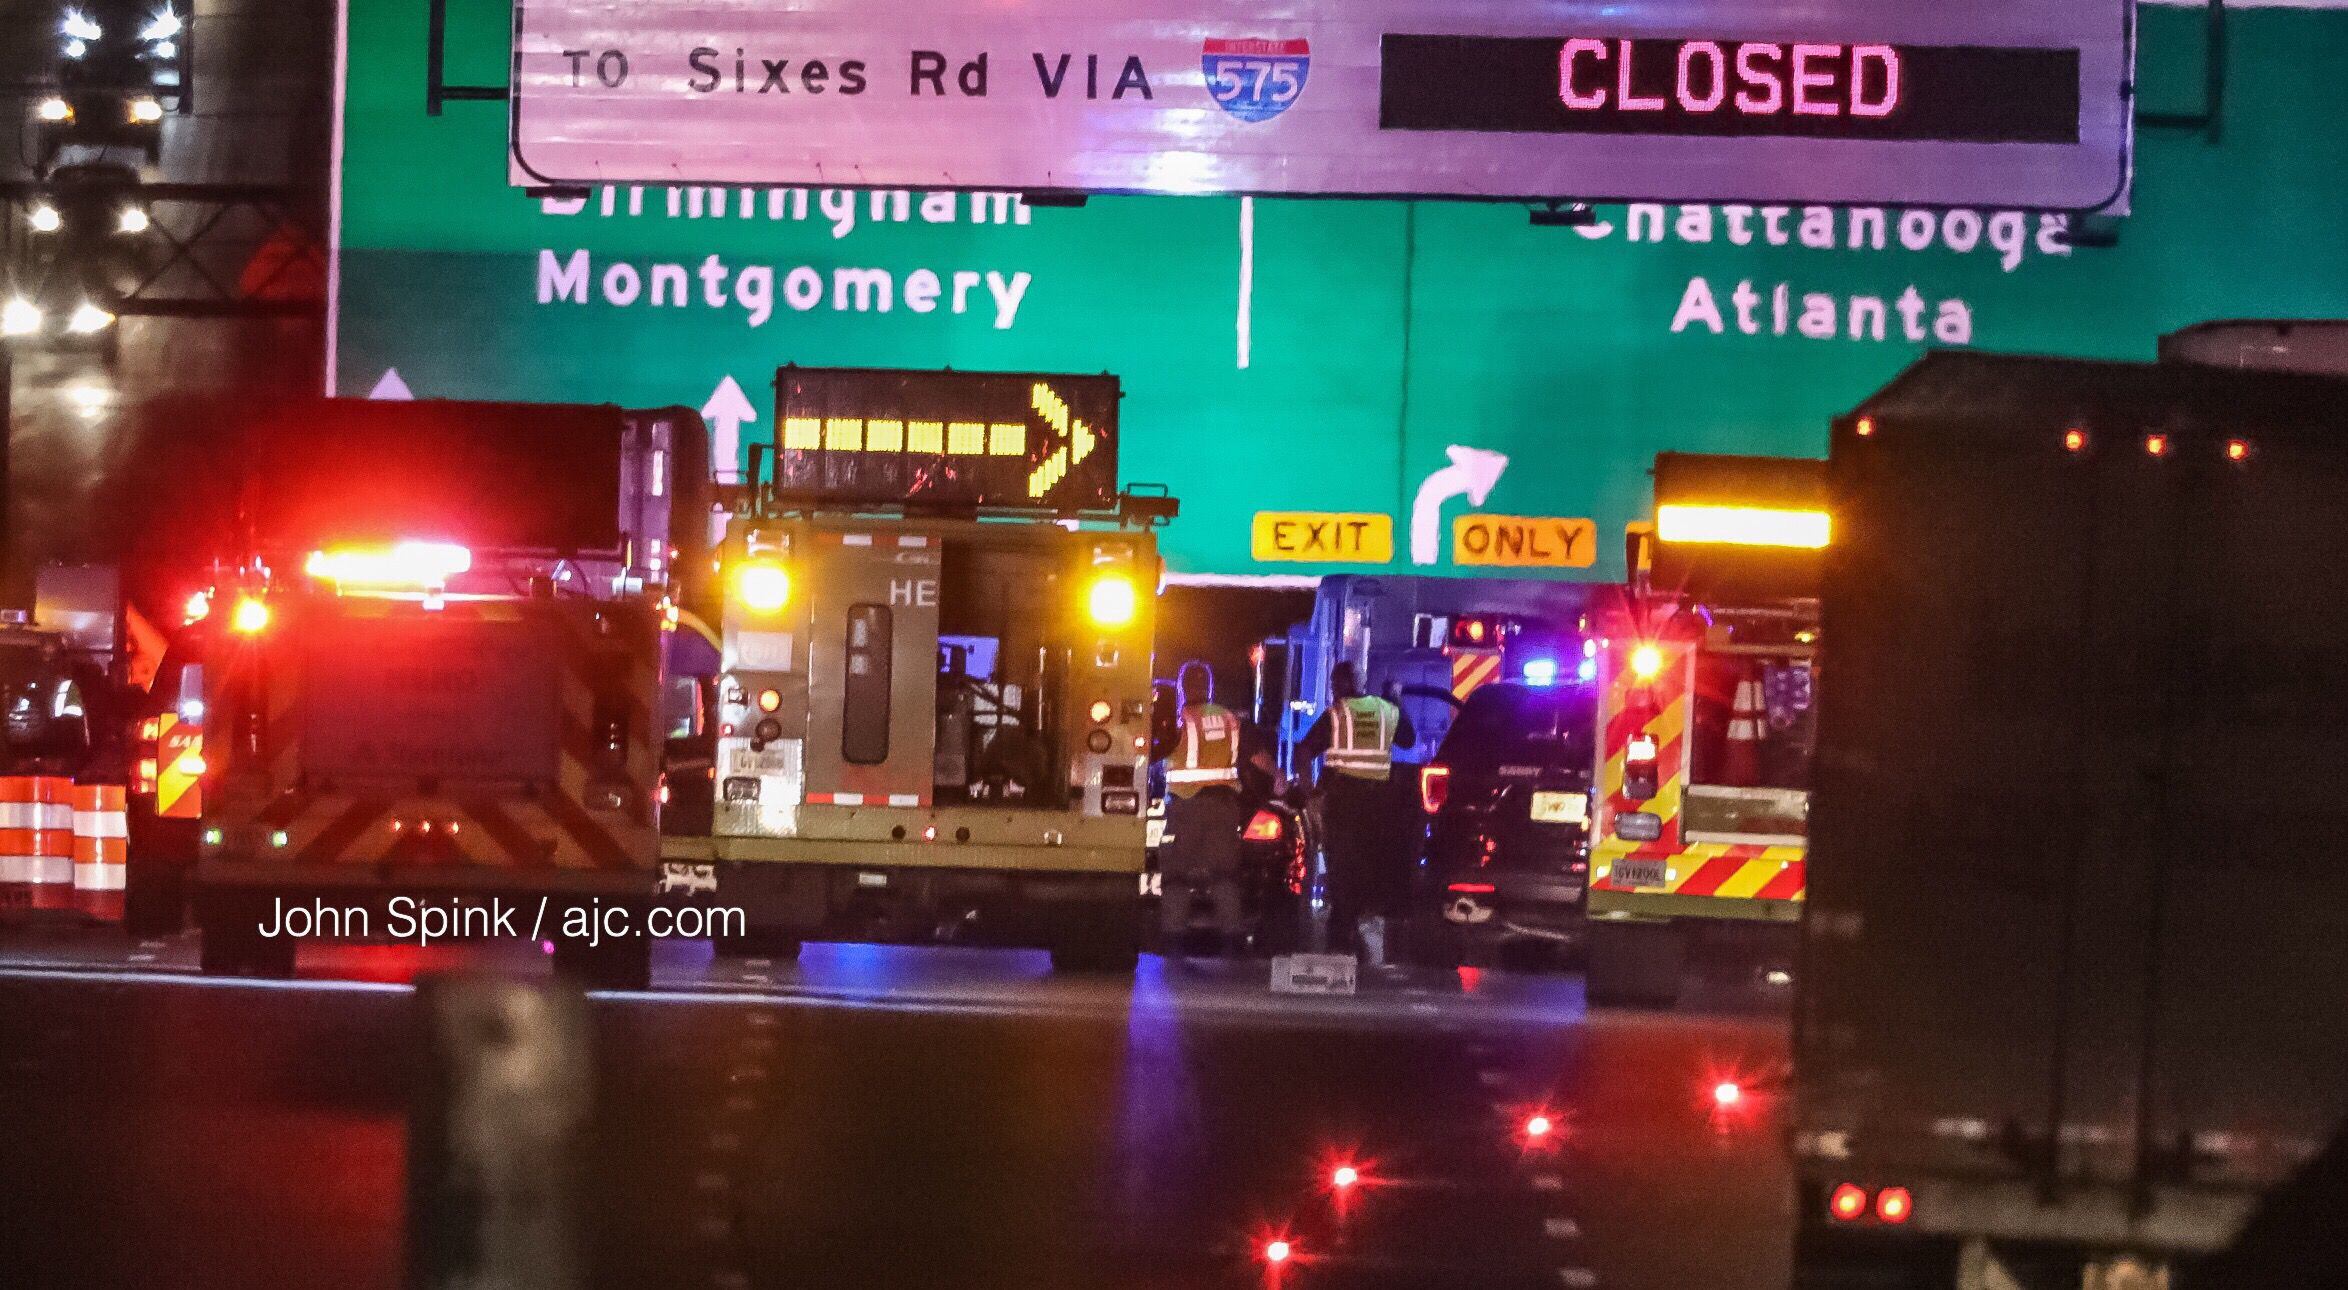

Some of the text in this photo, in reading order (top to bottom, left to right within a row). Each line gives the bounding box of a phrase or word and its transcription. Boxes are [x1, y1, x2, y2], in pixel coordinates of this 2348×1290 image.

[561, 46, 1154, 101] TO Sixes Rd VIA
[1216, 60, 1299, 102] 575
[1558, 37, 1901, 118] CLOSED
[537, 249, 1032, 329] Montgomery
[1670, 276, 1973, 344] Atlanta
[1273, 520, 1369, 552] EXIT
[1463, 523, 1583, 559] ONLY
